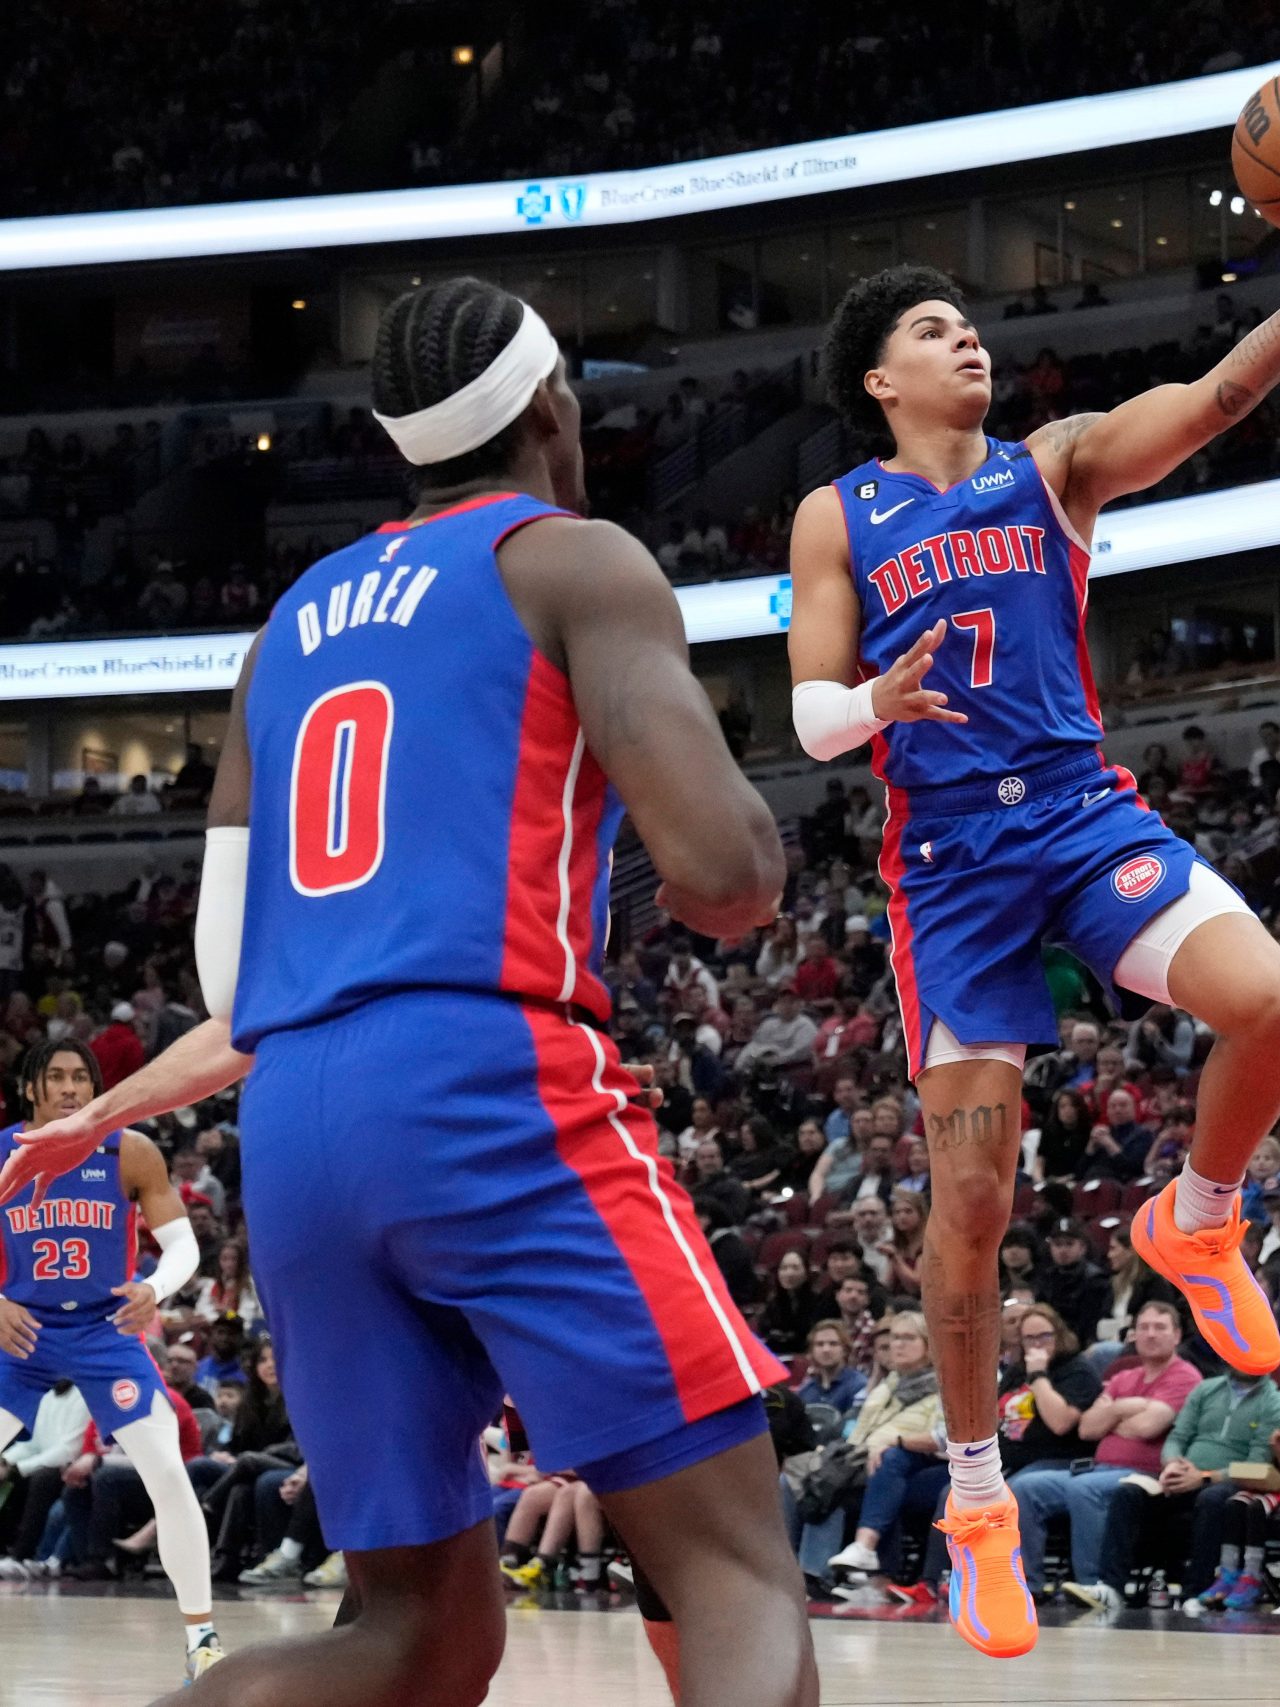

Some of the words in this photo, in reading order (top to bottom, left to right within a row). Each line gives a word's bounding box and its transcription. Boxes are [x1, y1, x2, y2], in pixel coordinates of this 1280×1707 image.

[860, 483, 875, 499] 6
[971, 469, 1014, 490] UWM
[868, 525, 1046, 617] DETROIT
[297, 565, 438, 656] DUREN
[951, 608, 995, 688] 7
[289, 680, 394, 897] 0
[929, 1103, 1007, 1151] 2001
[81, 1168, 106, 1179] UWM
[6, 1198, 116, 1234] DETROIT
[33, 1237, 90, 1281] 23
